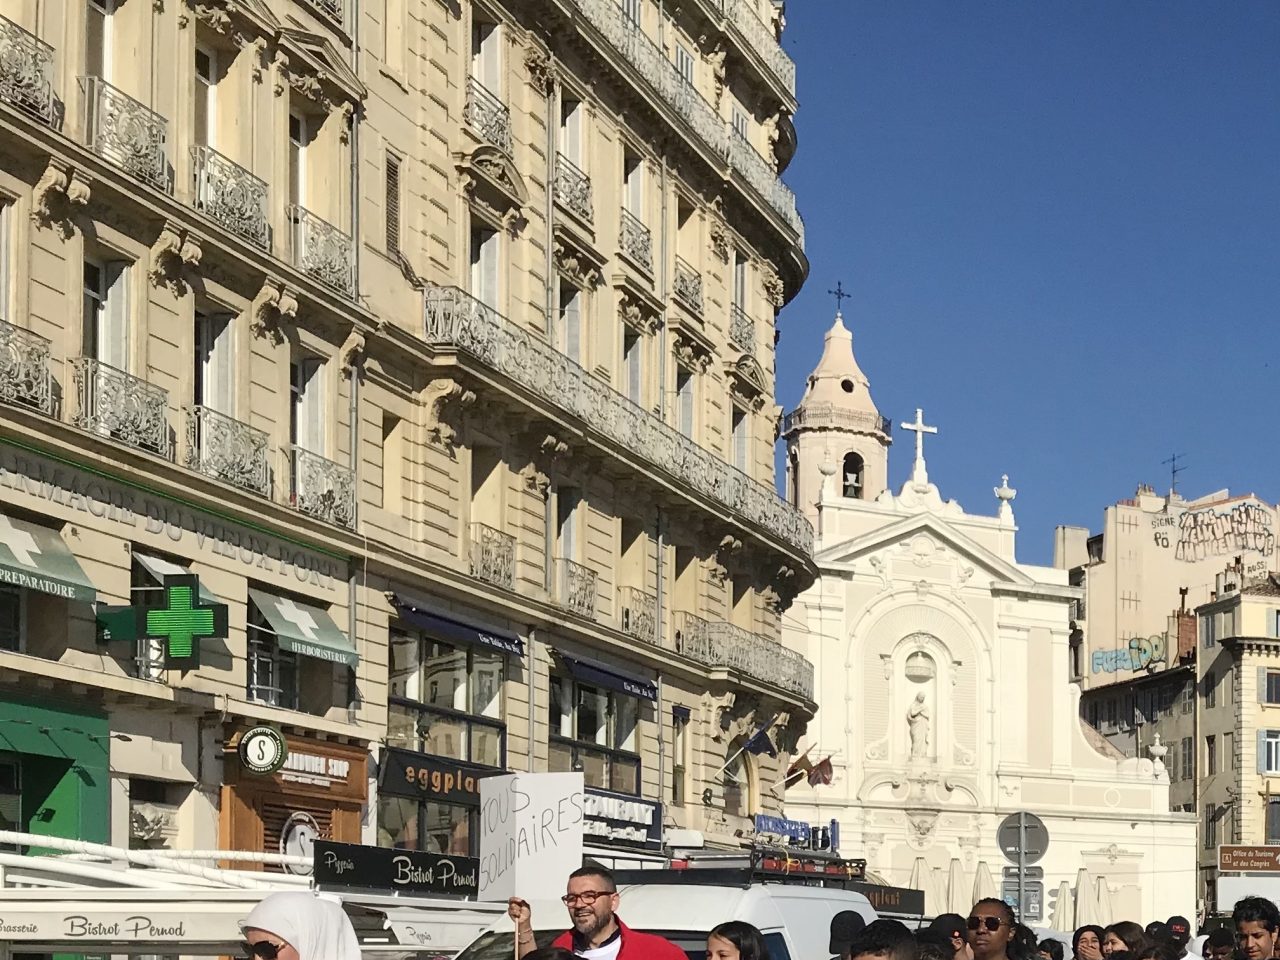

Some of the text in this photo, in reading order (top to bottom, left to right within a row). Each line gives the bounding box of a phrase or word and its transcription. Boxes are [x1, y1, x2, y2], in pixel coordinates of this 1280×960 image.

[291, 641, 349, 664] HERBORISTERIE
[480, 777, 530, 837] TOUS
[1255, 850, 1274, 858] Tourisme
[392, 855, 476, 888] Bistrot Pernod
[63, 915, 120, 937] Bistrot
[125, 915, 186, 938] Pernod
